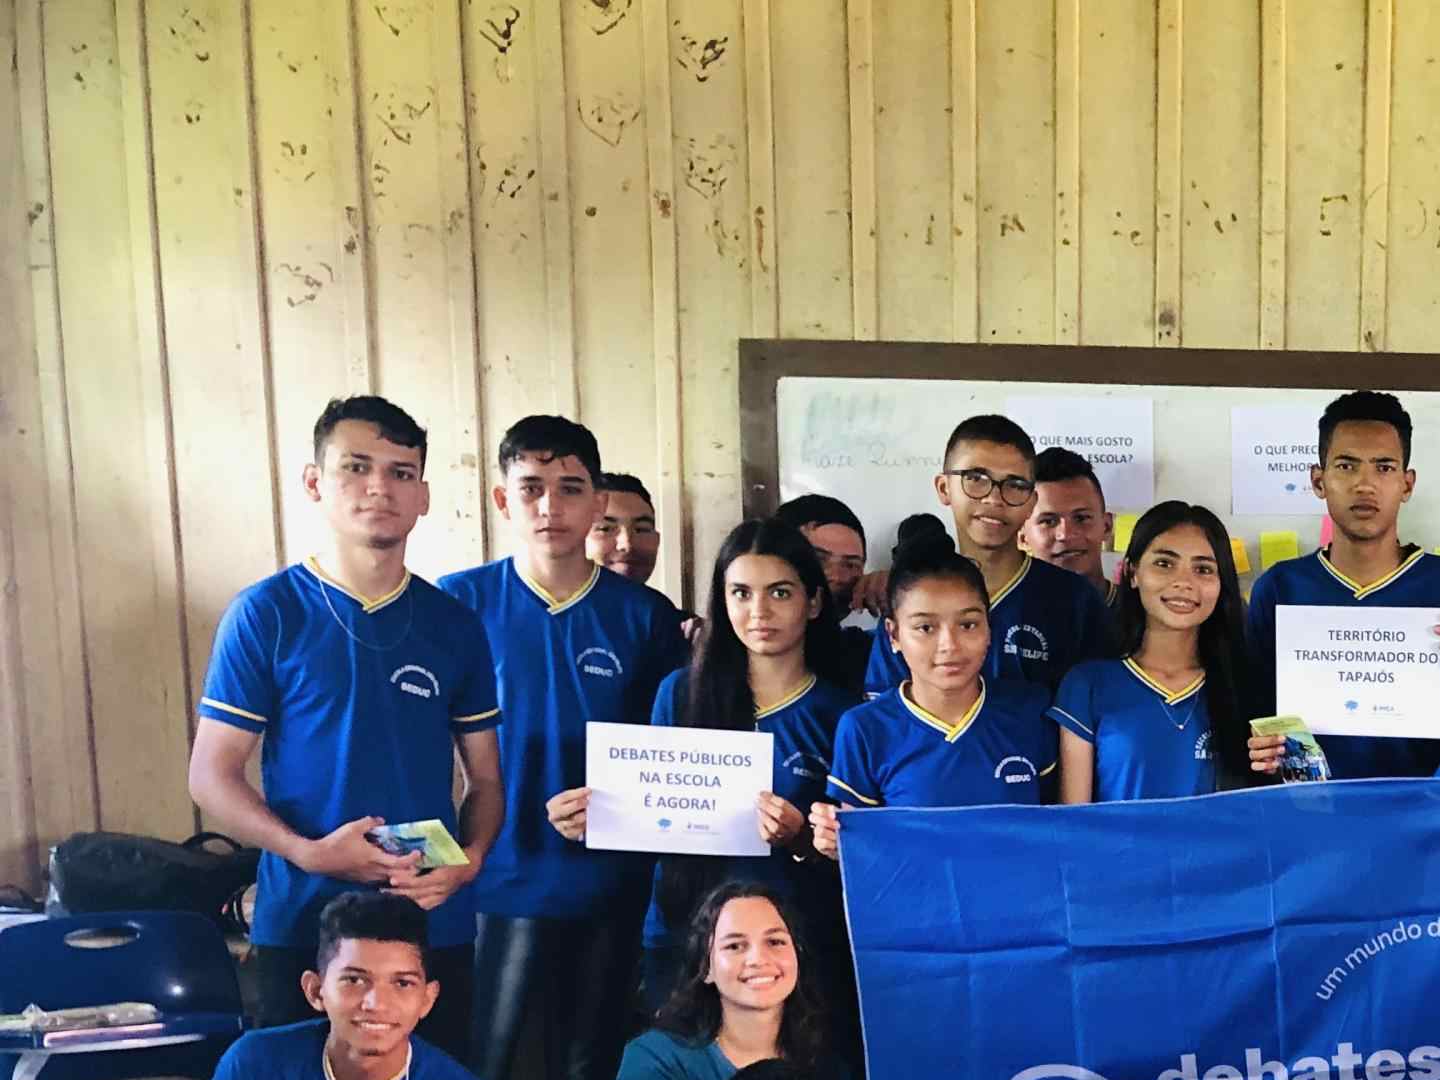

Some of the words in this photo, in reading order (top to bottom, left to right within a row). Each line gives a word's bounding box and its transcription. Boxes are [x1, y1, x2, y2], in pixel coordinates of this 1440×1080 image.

[1039, 436, 1066, 446] QUE
[1065, 436, 1093, 446] MAIS
[1096, 436, 1133, 447] GOSTO
[1254, 445, 1263, 455] O
[1265, 446, 1288, 456] QUE
[1291, 446, 1319, 455] PREC
[1088, 454, 1134, 464] ESCOLA?
[1268, 463, 1317, 472] MELHOR
[1328, 628, 1406, 642] TERRITÓRIO
[1294, 649, 1416, 664] TRANSFORMADOR
[1418, 652, 1439, 664] DO
[1338, 669, 1395, 683] TAPAJÓS
[608, 746, 676, 763] DEBATES
[680, 748, 753, 767] PÚBLICOS
[639, 771, 662, 785] NA
[666, 772, 722, 788] ESCOLA
[644, 793, 653, 808] É
[656, 796, 717, 811] AGORA!
[1315, 966, 1348, 1001] um
[1344, 921, 1423, 970] mundo
